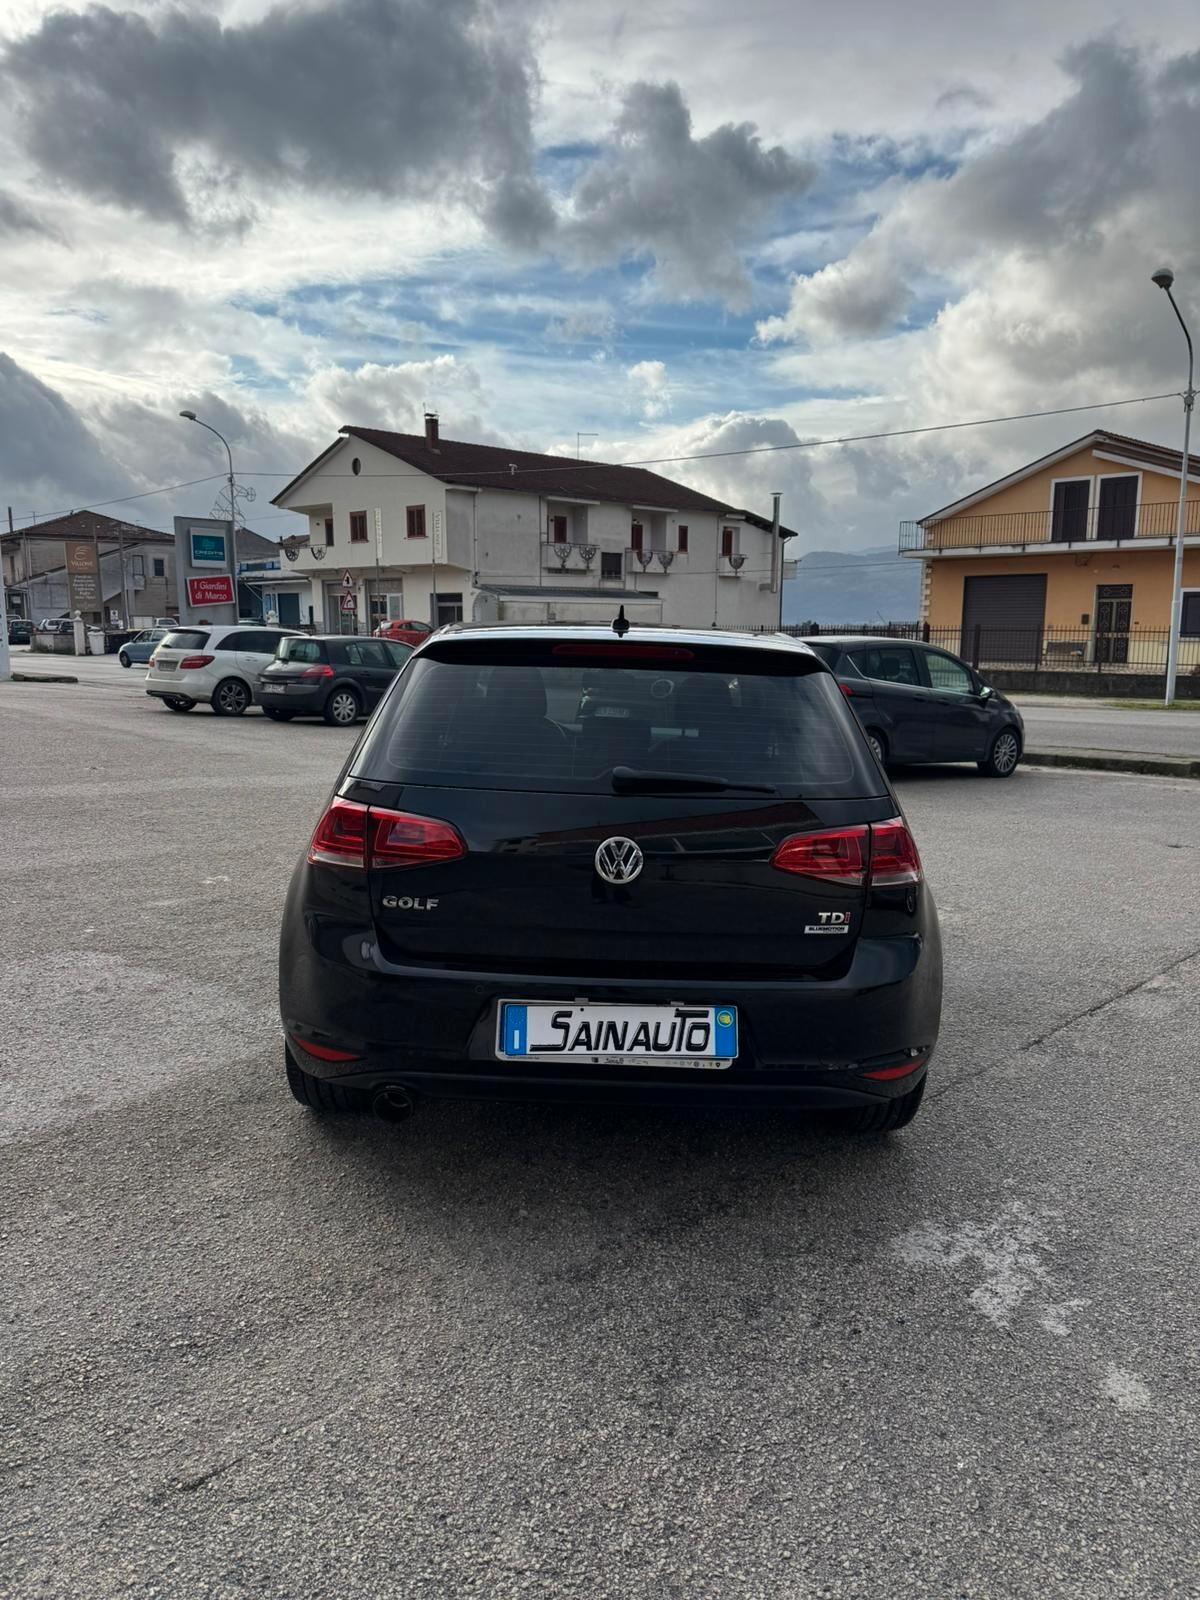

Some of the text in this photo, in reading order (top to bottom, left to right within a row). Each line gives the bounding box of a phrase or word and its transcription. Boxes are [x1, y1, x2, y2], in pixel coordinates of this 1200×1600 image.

[199, 581, 228, 591] Giardini
[195, 591, 228, 601] di Marzo
[382, 895, 440, 911] GOLF
[529, 1009, 710, 1052] SAINAUTO
